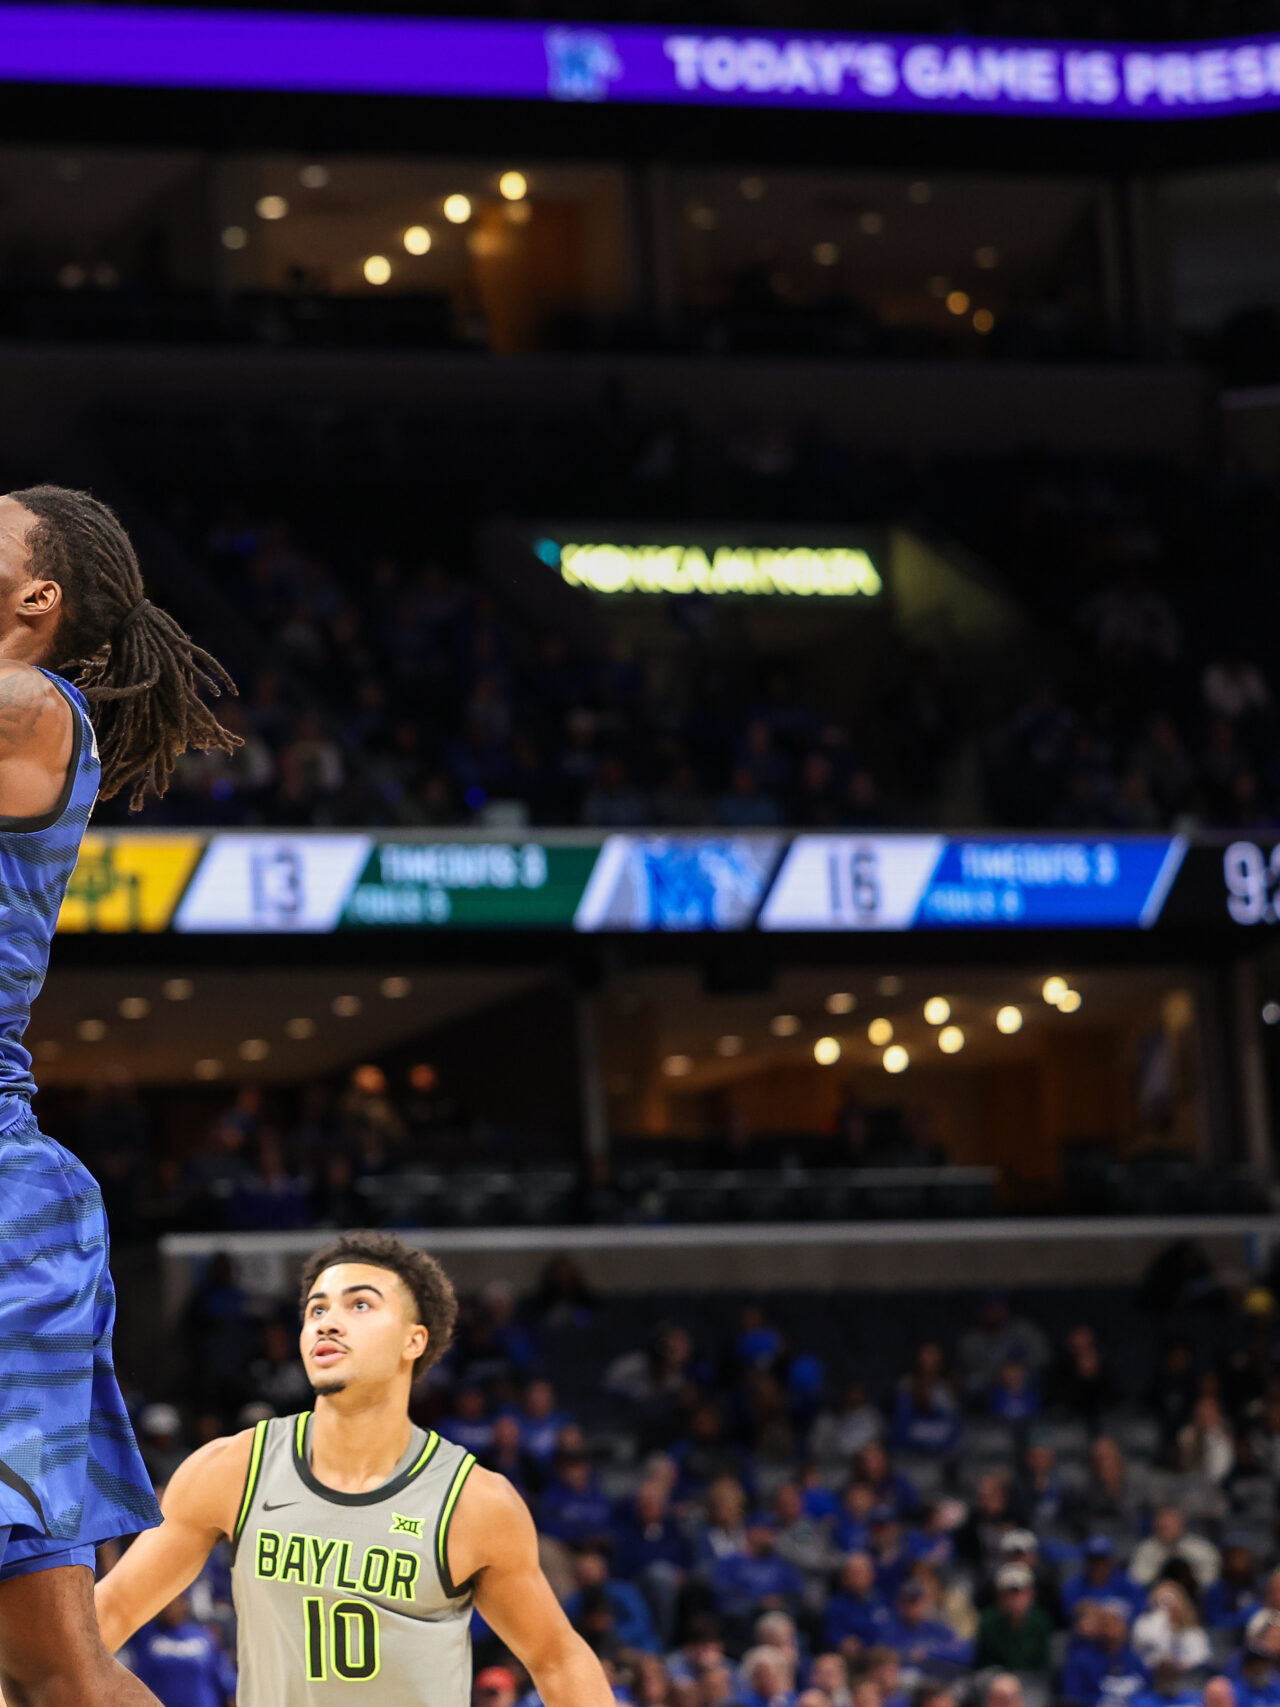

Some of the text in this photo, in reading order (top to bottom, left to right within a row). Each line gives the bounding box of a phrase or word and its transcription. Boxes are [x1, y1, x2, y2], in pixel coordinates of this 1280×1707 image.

[664, 35, 898, 97] TODAY'S
[901, 44, 1060, 102] GAME
[1063, 51, 1119, 105] IS
[826, 845, 881, 925] 16
[255, 1529, 421, 1601] BAYLOR
[303, 1596, 380, 1681] 10
